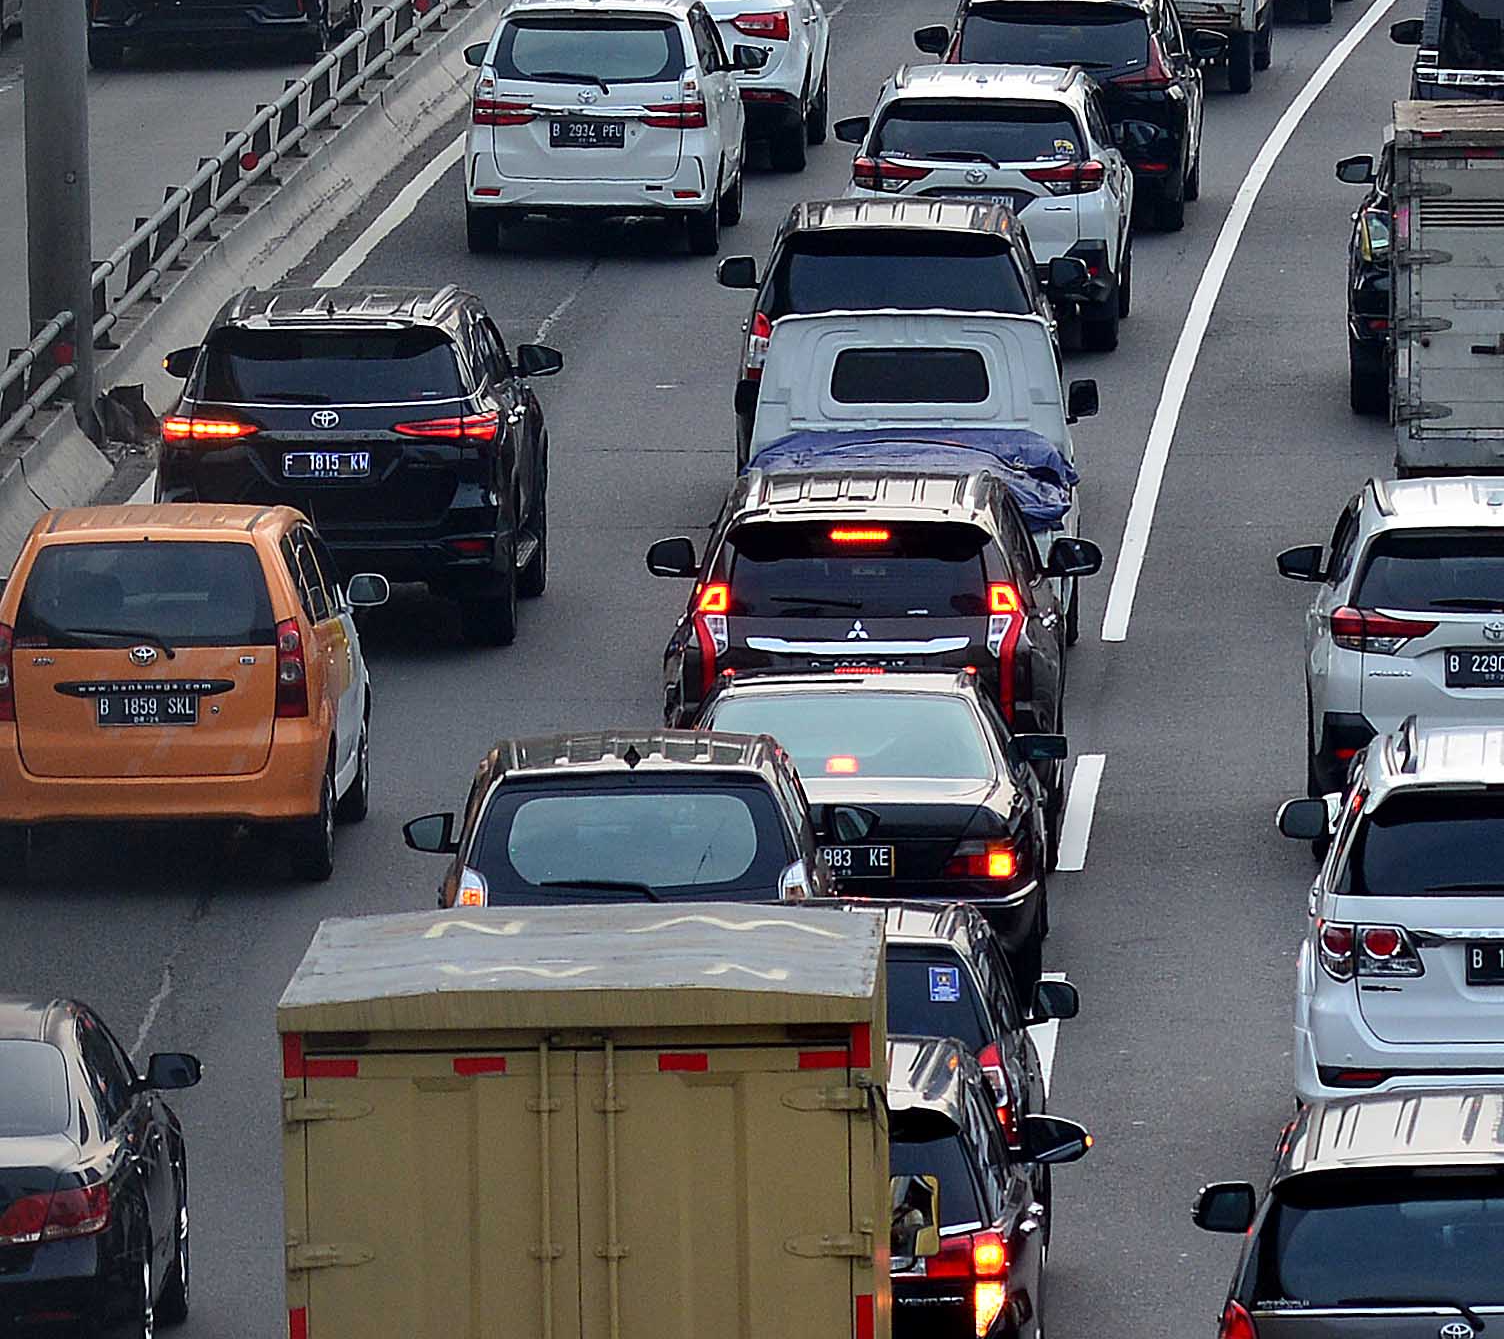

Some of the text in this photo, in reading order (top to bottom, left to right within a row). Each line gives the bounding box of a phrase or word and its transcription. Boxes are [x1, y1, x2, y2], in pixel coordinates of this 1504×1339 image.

[552, 123, 626, 138] B 2934 PFU
[284, 453, 371, 470] F 1815 KW
[1450, 654, 1460, 672] B
[78, 682, 213, 693] www.bankmega.com
[99, 697, 195, 715] B 1859 SKL
[869, 848, 890, 867] KE
[1473, 948, 1484, 969] B
